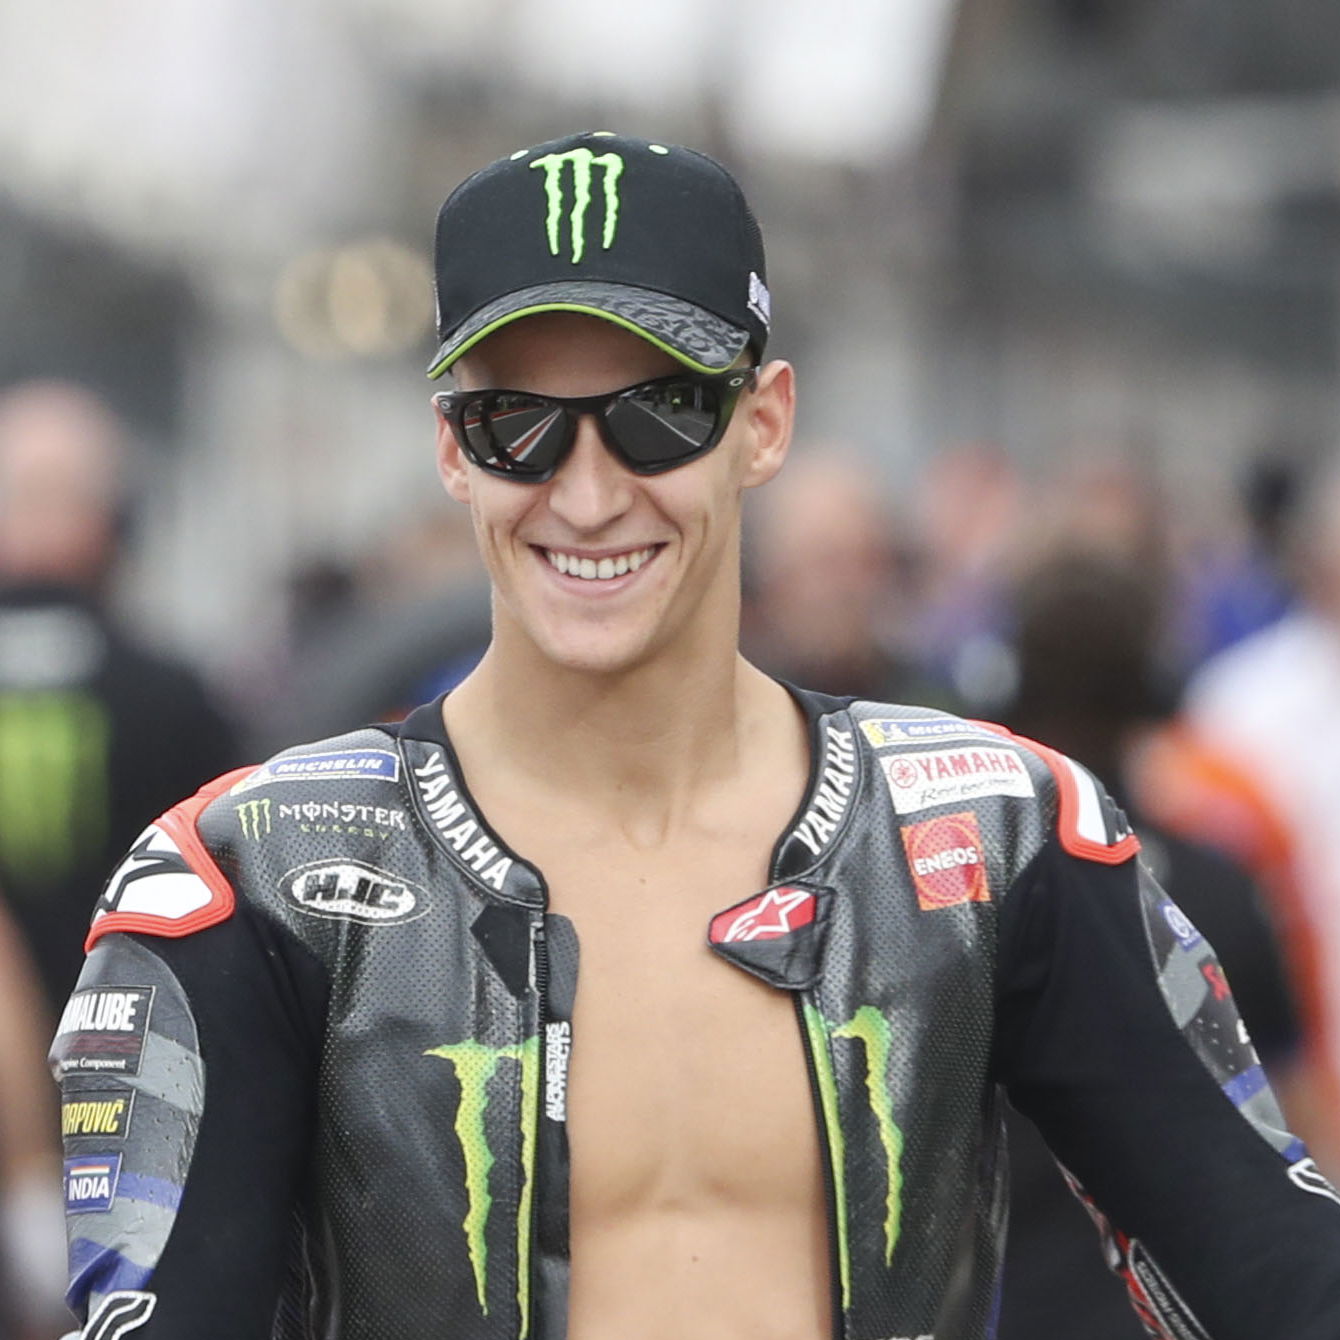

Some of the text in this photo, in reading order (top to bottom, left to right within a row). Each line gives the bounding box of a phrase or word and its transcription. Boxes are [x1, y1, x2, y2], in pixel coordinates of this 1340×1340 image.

[275, 759, 383, 775] MICHELIN
[917, 752, 1022, 781] YAMAHA
[794, 727, 853, 855] YAMAHA
[279, 801, 406, 830] MONSTER
[414, 752, 515, 890] YAMAHA
[300, 824, 389, 841] ENERGY
[915, 846, 978, 876] ENEOS
[302, 873, 404, 911] HJC
